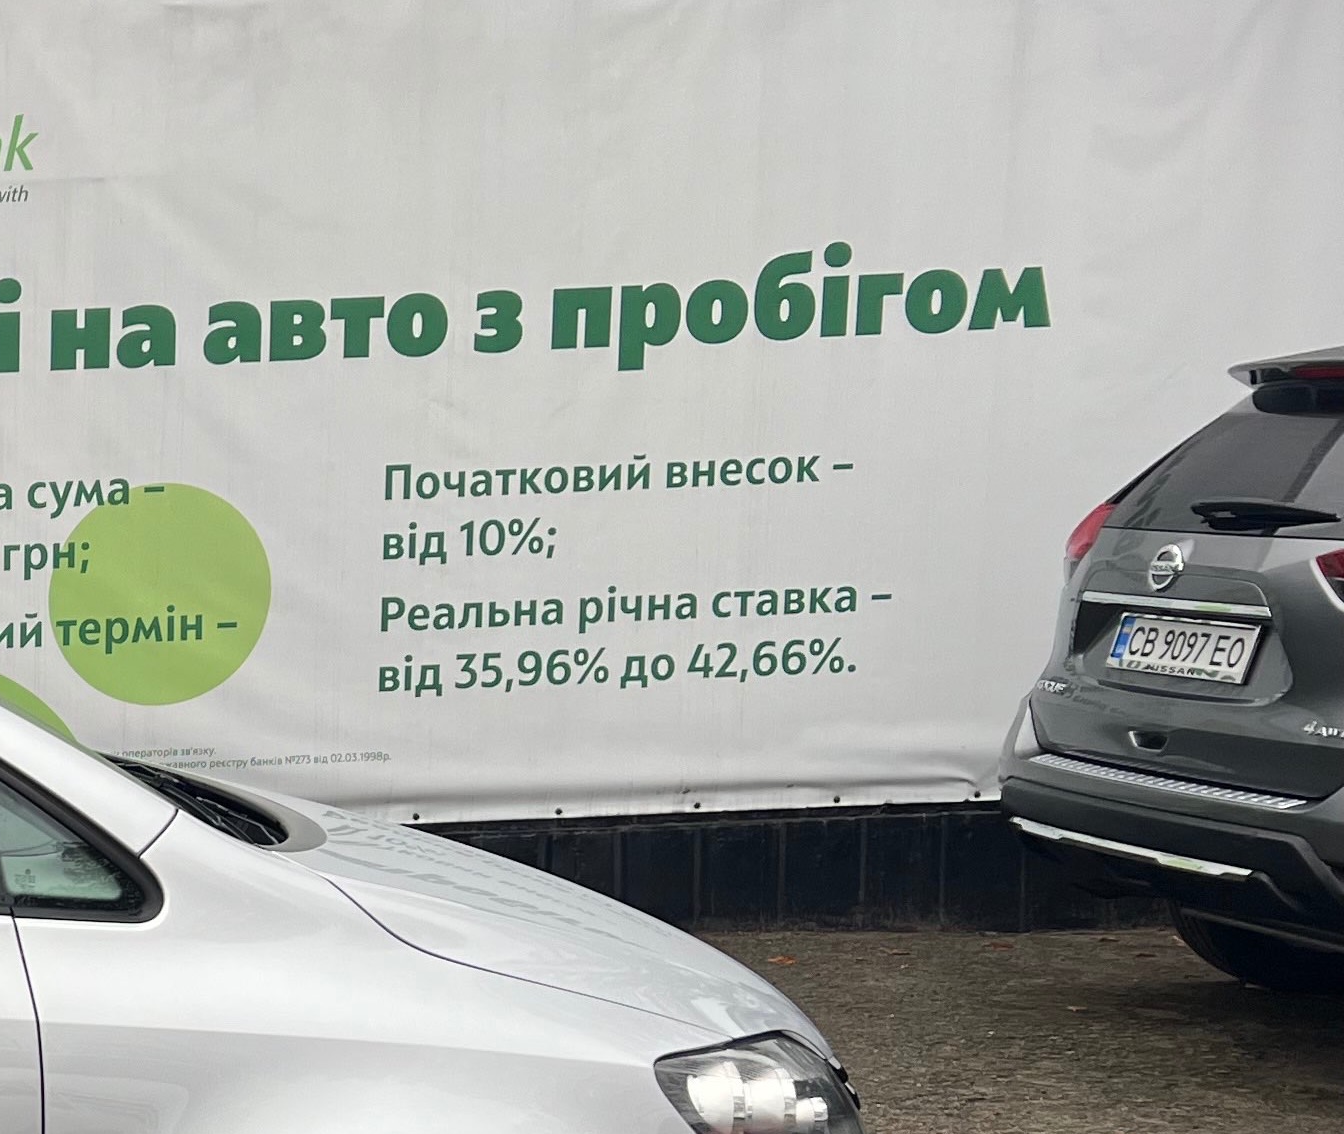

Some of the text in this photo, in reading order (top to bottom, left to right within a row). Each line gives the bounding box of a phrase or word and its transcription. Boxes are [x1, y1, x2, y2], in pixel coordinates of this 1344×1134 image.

[50, 304, 176, 371] на
[203, 293, 448, 365] авто
[473, 290, 523, 354] з
[551, 241, 1051, 372] пробігом
[27, 478, 130, 521] сума
[384, 454, 650, 501] Початковий
[666, 455, 820, 489] внесок
[2, 539, 90, 581] грн;
[383, 517, 557, 566] від 10%;
[55, 604, 203, 655] термін
[380, 596, 563, 632] Реальна
[578, 585, 697, 634] річна
[712, 584, 857, 618] ставка
[378, 637, 856, 698] від 35,96% до 42,66%.
[1128, 626, 1245, 668] CB 9097 EO
[249, 756, 283, 767] банків
